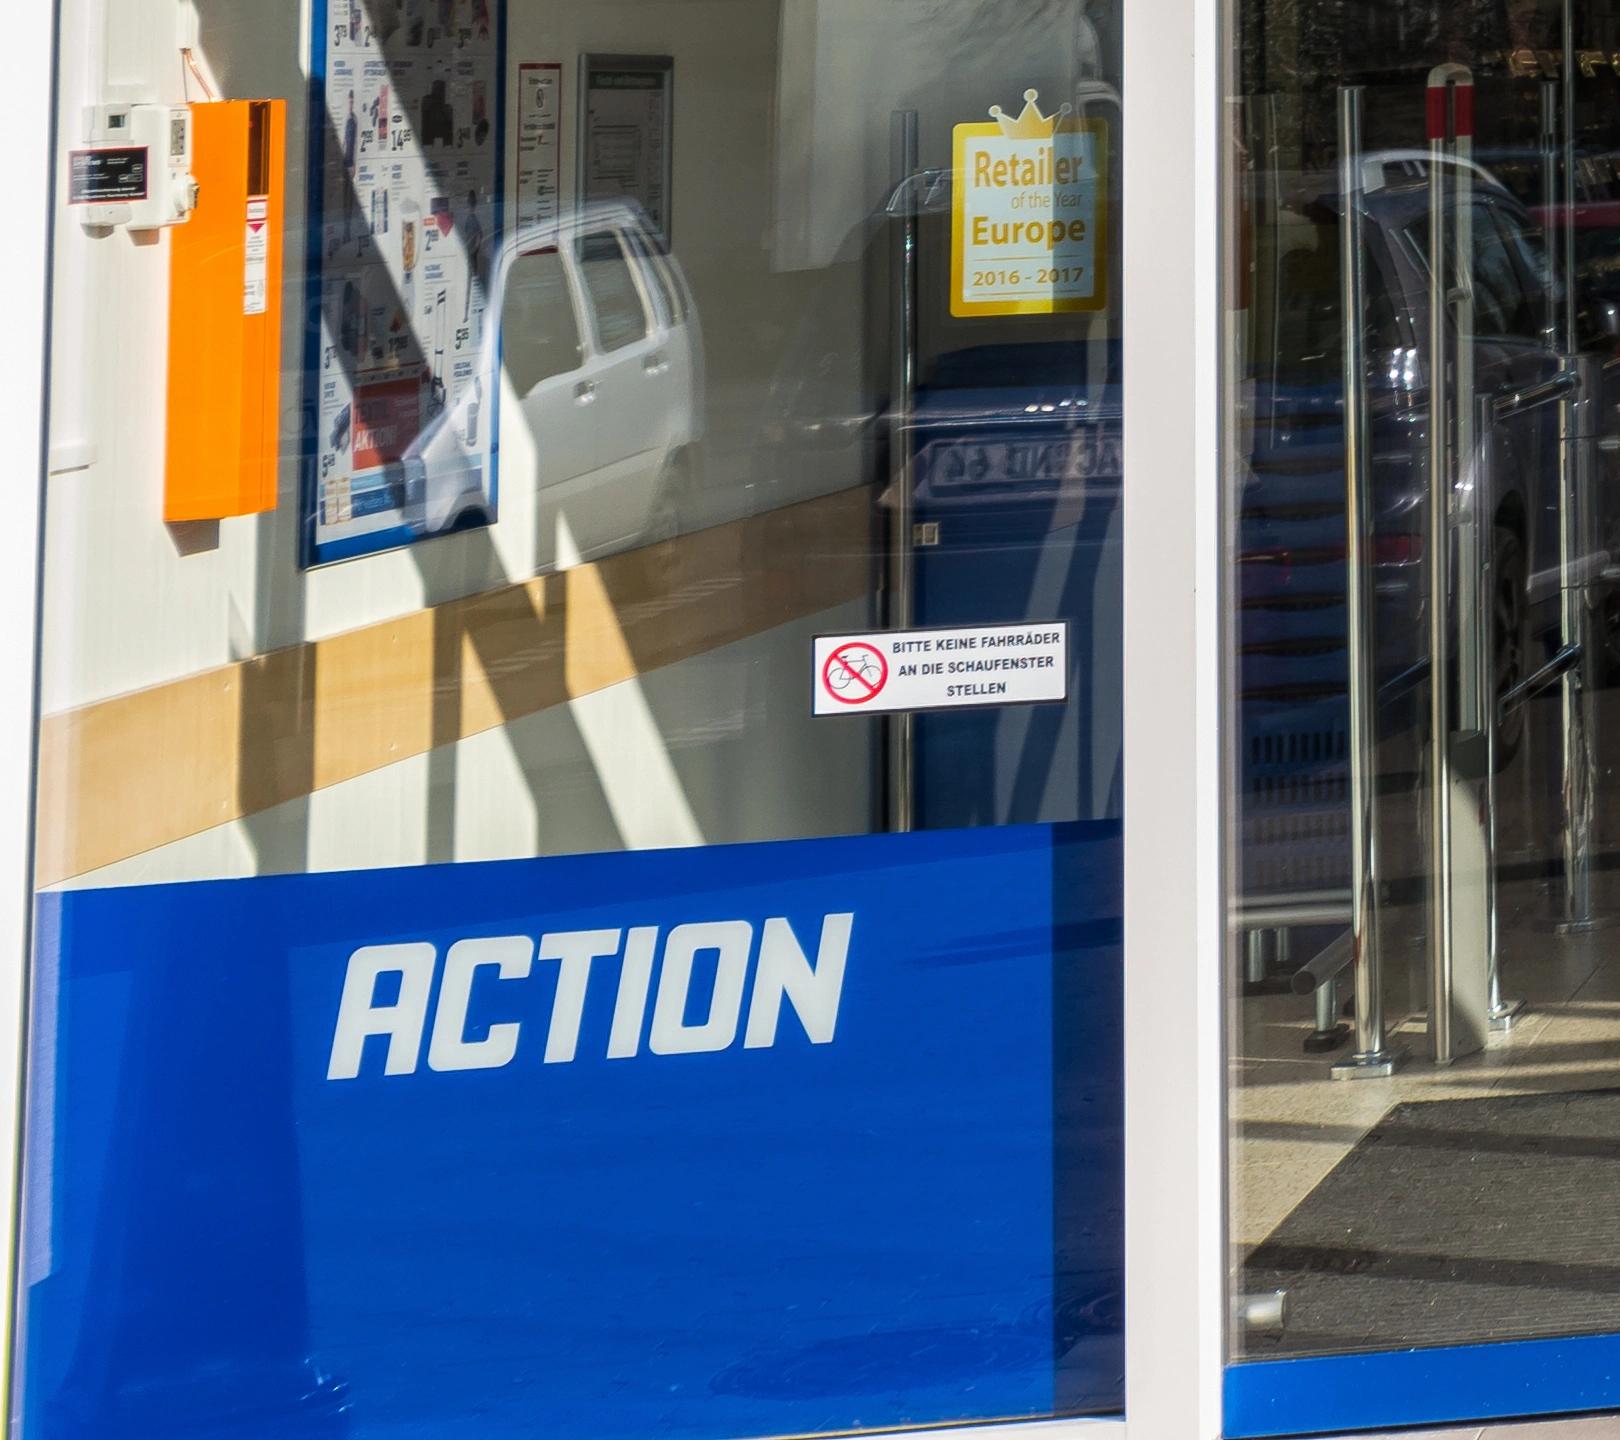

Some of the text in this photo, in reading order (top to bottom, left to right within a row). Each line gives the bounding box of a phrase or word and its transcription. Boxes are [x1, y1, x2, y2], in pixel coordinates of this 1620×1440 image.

[973, 146, 1083, 188] Retailer
[1011, 191, 1083, 209] of the Year
[971, 215, 1087, 252] Europe
[973, 270, 1020, 287] 2016
[1036, 267, 1084, 284] 2017
[892, 631, 1060, 654] BITTE KEINE FAHRRÄDER
[898, 655, 1055, 677] AN DIE SCHAUFENSTER
[946, 681, 1007, 698] STELLEN
[327, 912, 855, 1081] ACTION
